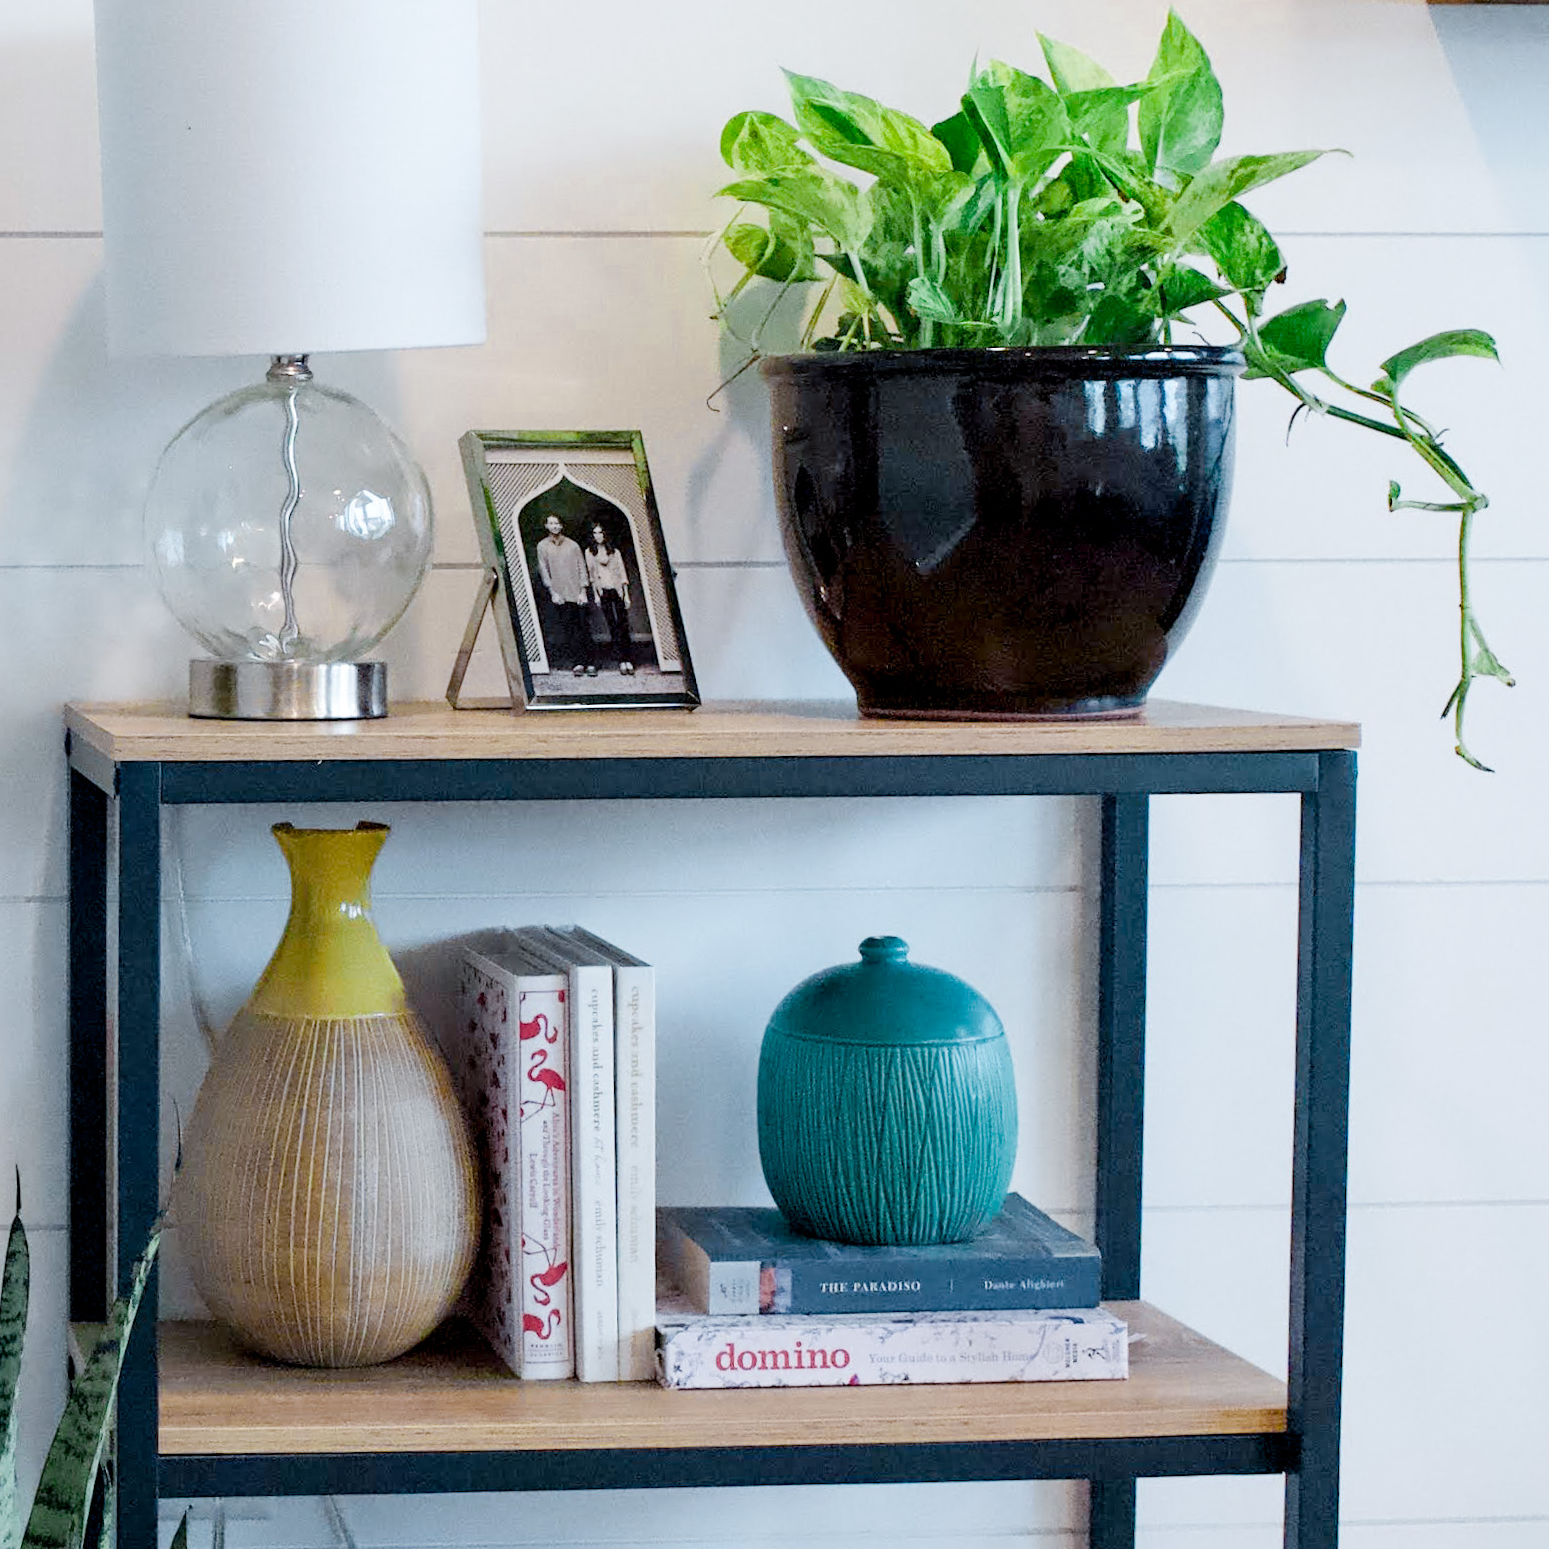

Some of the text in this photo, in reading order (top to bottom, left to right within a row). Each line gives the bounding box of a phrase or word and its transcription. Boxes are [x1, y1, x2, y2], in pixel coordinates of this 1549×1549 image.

[628, 985, 644, 1047] cupcakes
[588, 988, 604, 1132] cupcakes and cashmere
[631, 1081, 644, 1148] cashmere
[529, 1152, 538, 1208] Lewis Carroll
[594, 1200, 606, 1233] emily
[820, 1280, 921, 1294] THE PARADISO
[984, 1277, 1065, 1292] Dante Alighieri
[715, 1341, 851, 1371] domino
[869, 1353, 895, 1364] Your
[898, 1352, 934, 1364] Guide
[936, 1352, 947, 1363] to
[959, 1351, 998, 1364] Stylish
